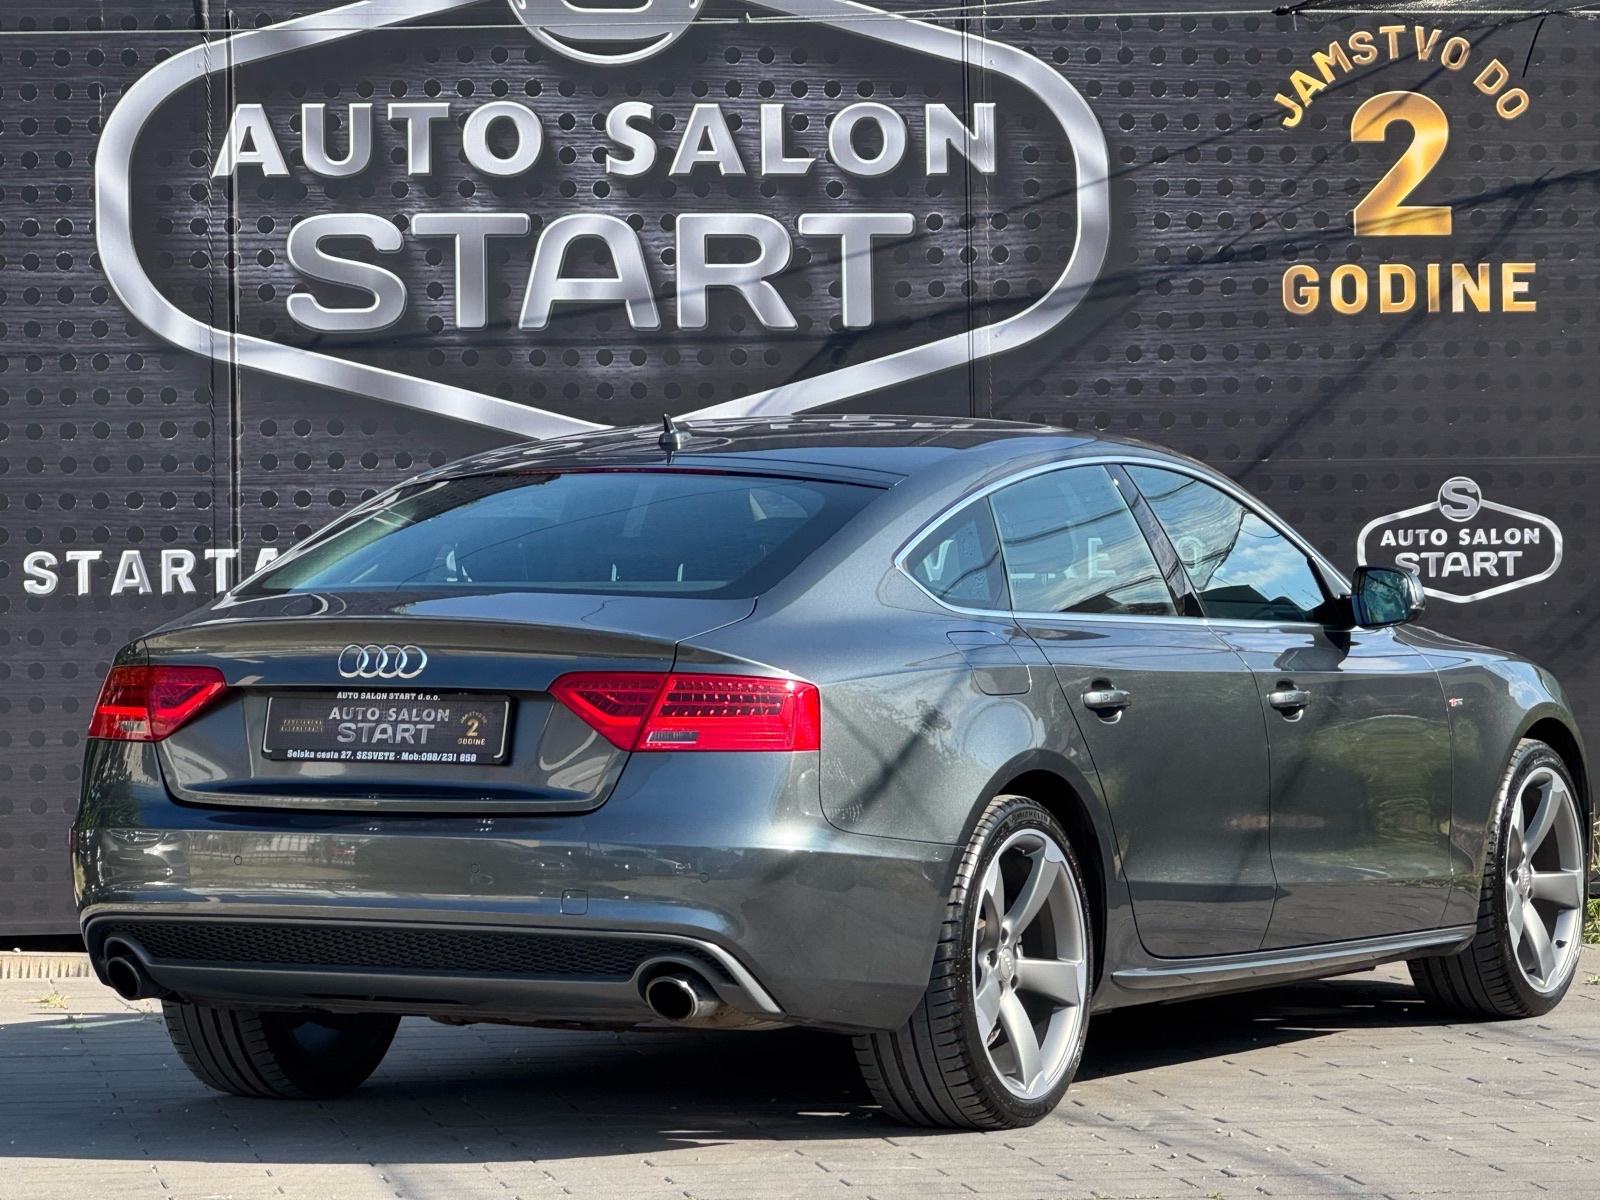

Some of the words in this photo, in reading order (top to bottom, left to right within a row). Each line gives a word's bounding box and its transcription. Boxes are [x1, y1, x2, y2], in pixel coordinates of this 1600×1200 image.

[1274, 25, 1470, 127] JAMSTVO
[1473, 58, 1530, 120] DO
[211, 101, 544, 178] AUTO
[605, 101, 997, 177] SALON
[1351, 90, 1452, 236] 2
[286, 212, 916, 333] START
[1282, 263, 1537, 315] GODINE
[1380, 528, 1448, 547] AUTO
[1459, 527, 1540, 545] SALON
[1395, 550, 1523, 578] START
[336, 691, 359, 700] AUTO
[360, 692, 388, 700] SALON
[388, 692, 416, 701] START
[417, 693, 441, 701] d.o.o.
[329, 706, 380, 721] AUTO
[387, 707, 450, 722] SALON
[336, 722, 435, 745] START
[466, 719, 479, 737] 2
[286, 749, 315, 759] Selska
[316, 751, 339, 759] cesta
[355, 751, 395, 761] SESVETE
